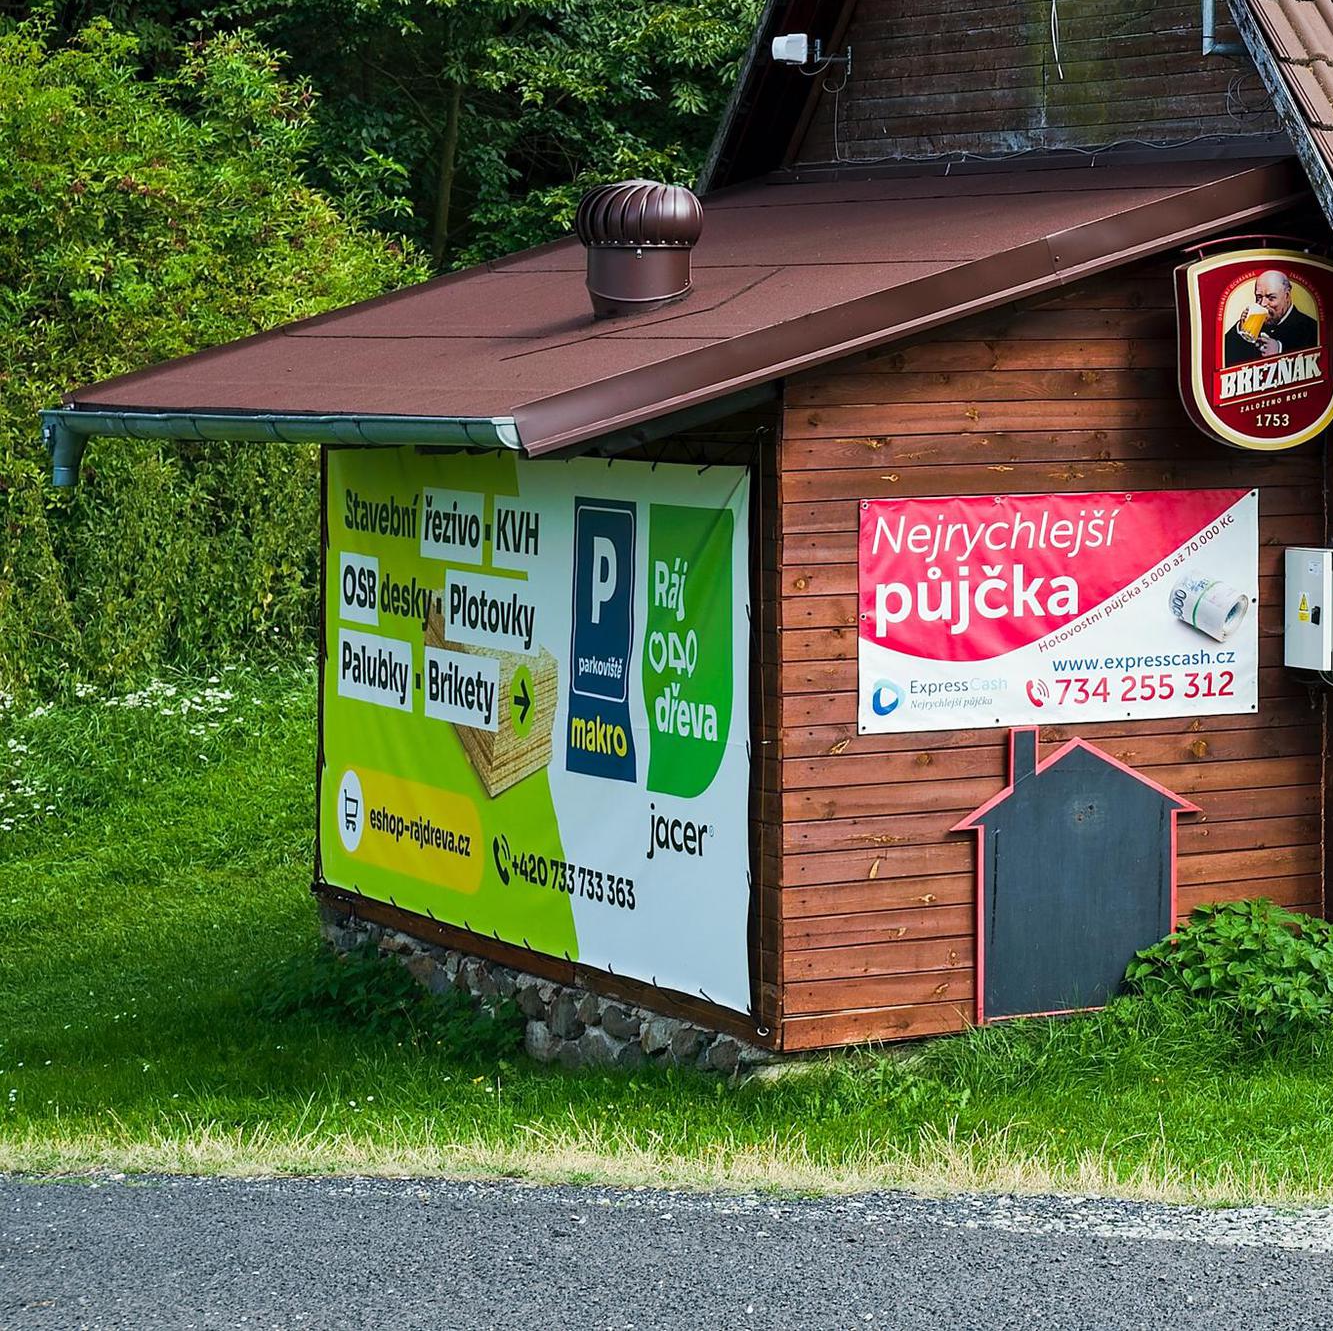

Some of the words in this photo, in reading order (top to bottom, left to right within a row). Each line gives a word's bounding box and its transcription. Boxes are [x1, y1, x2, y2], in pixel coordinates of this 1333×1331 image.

[1219, 352, 1322, 400] BŘEZŇÁK
[1240, 397, 1283, 414] ZALOŽENO
[1286, 391, 1309, 402] ROKU
[1256, 413, 1290, 427] 1753
[344, 488, 419, 539] Stavební
[424, 495, 480, 548] řezivo
[496, 508, 540, 556] KVH
[871, 509, 1120, 562] Nejrychlejší
[591, 536, 617, 624] P
[654, 558, 688, 622] Ráj
[875, 564, 1080, 638] půjčka
[1038, 611, 1102, 653] Hotovostní
[1105, 586, 1141, 617] půjčka
[1141, 563, 1171, 589] 5.000
[1173, 553, 1186, 568] až
[1184, 526, 1220, 557] 70.000
[1220, 513, 1235, 528] Kč
[343, 564, 377, 610] OSB
[380, 573, 432, 631] desky
[450, 583, 535, 650] Plotovky
[342, 641, 409, 705] Palubky
[428, 659, 495, 725] Brikety
[578, 656, 624, 680] parkoviště
[910, 677, 1008, 696] ExpressCash
[1052, 649, 1235, 672] www.expresscash.cz
[654, 682, 718, 742] dřeva
[910, 697, 962, 711] Nejrychlejší
[963, 696, 993, 708] půjčka
[1055, 677, 1110, 705] 734
[1121, 673, 1175, 702] 255
[1184, 671, 1234, 699] 312
[571, 715, 628, 758] makro
[370, 806, 471, 857] eshop-rajdreva.cz
[647, 802, 707, 860] jacer
[512, 852, 548, 887] +420
[550, 859, 575, 894] 733
[578, 866, 604, 902] 733
[606, 874, 636, 910] 363
